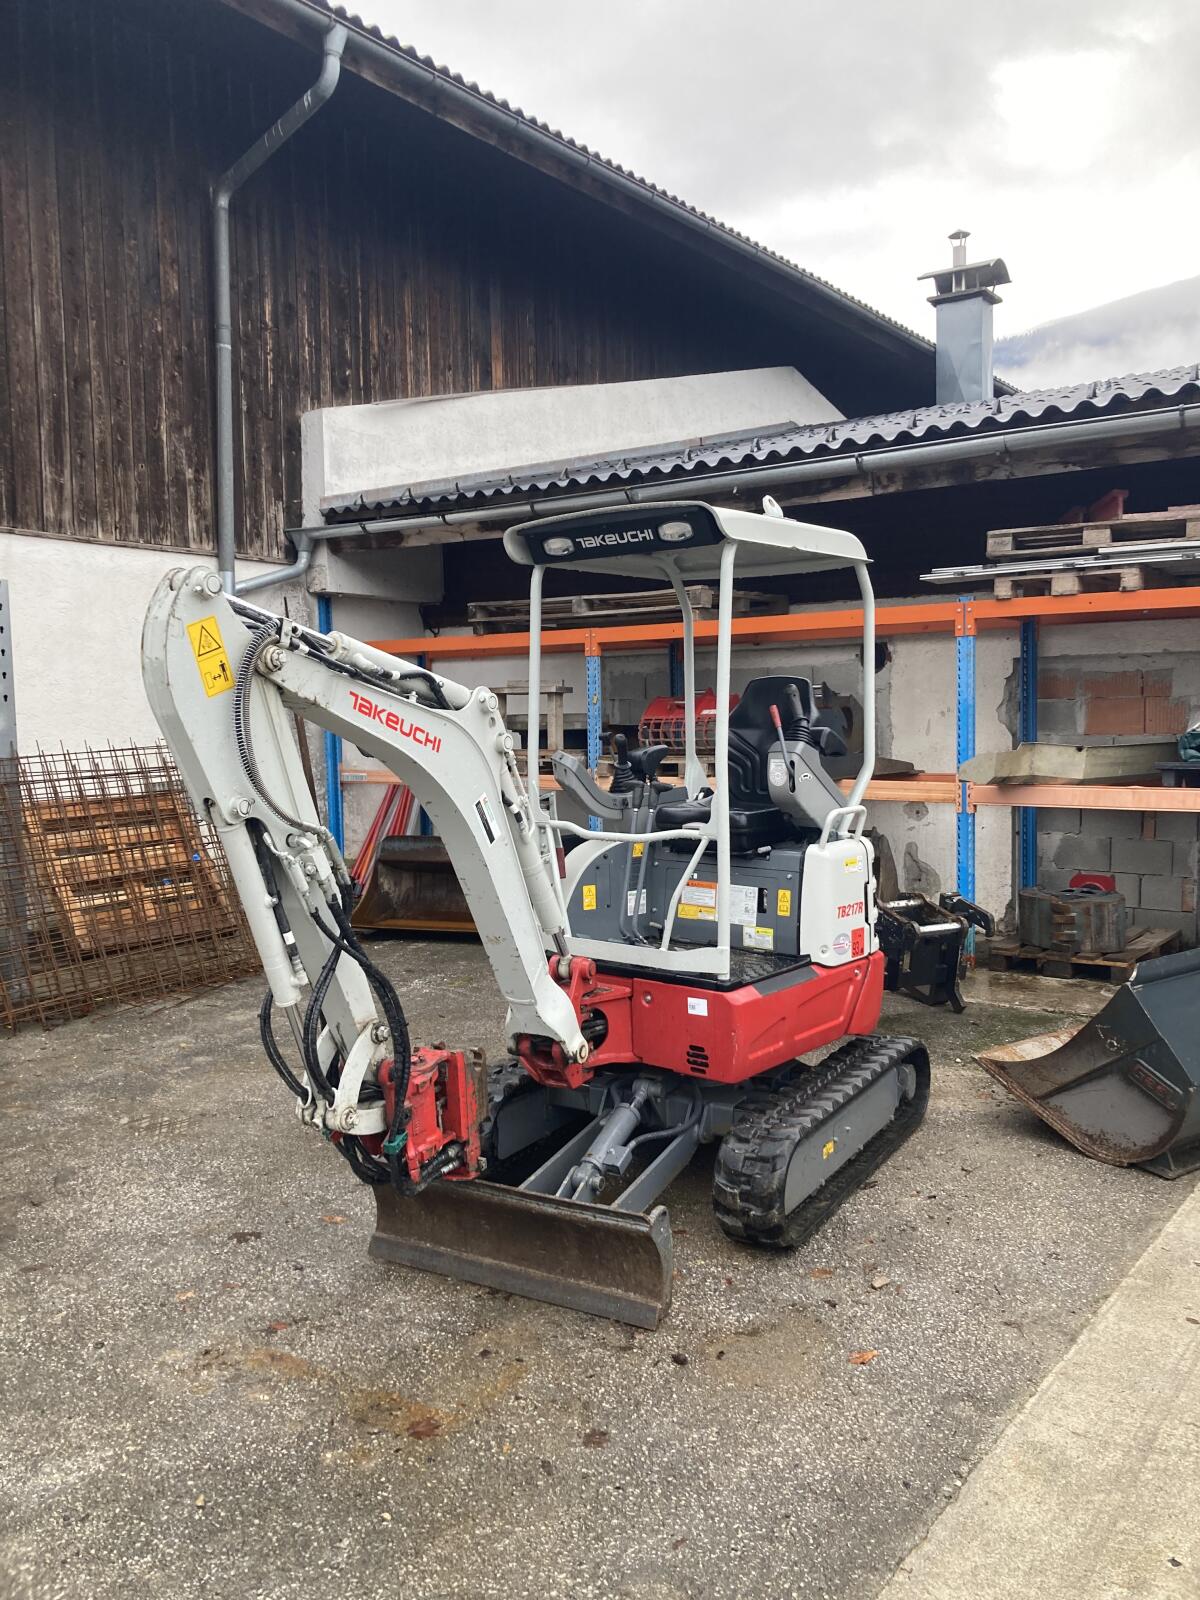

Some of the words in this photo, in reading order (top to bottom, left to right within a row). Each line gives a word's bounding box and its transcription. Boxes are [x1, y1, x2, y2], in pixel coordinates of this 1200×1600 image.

[575, 529, 654, 549] TAKEUCHI
[349, 690, 442, 753] TAKEUCHI
[837, 901, 863, 919] TB217R
